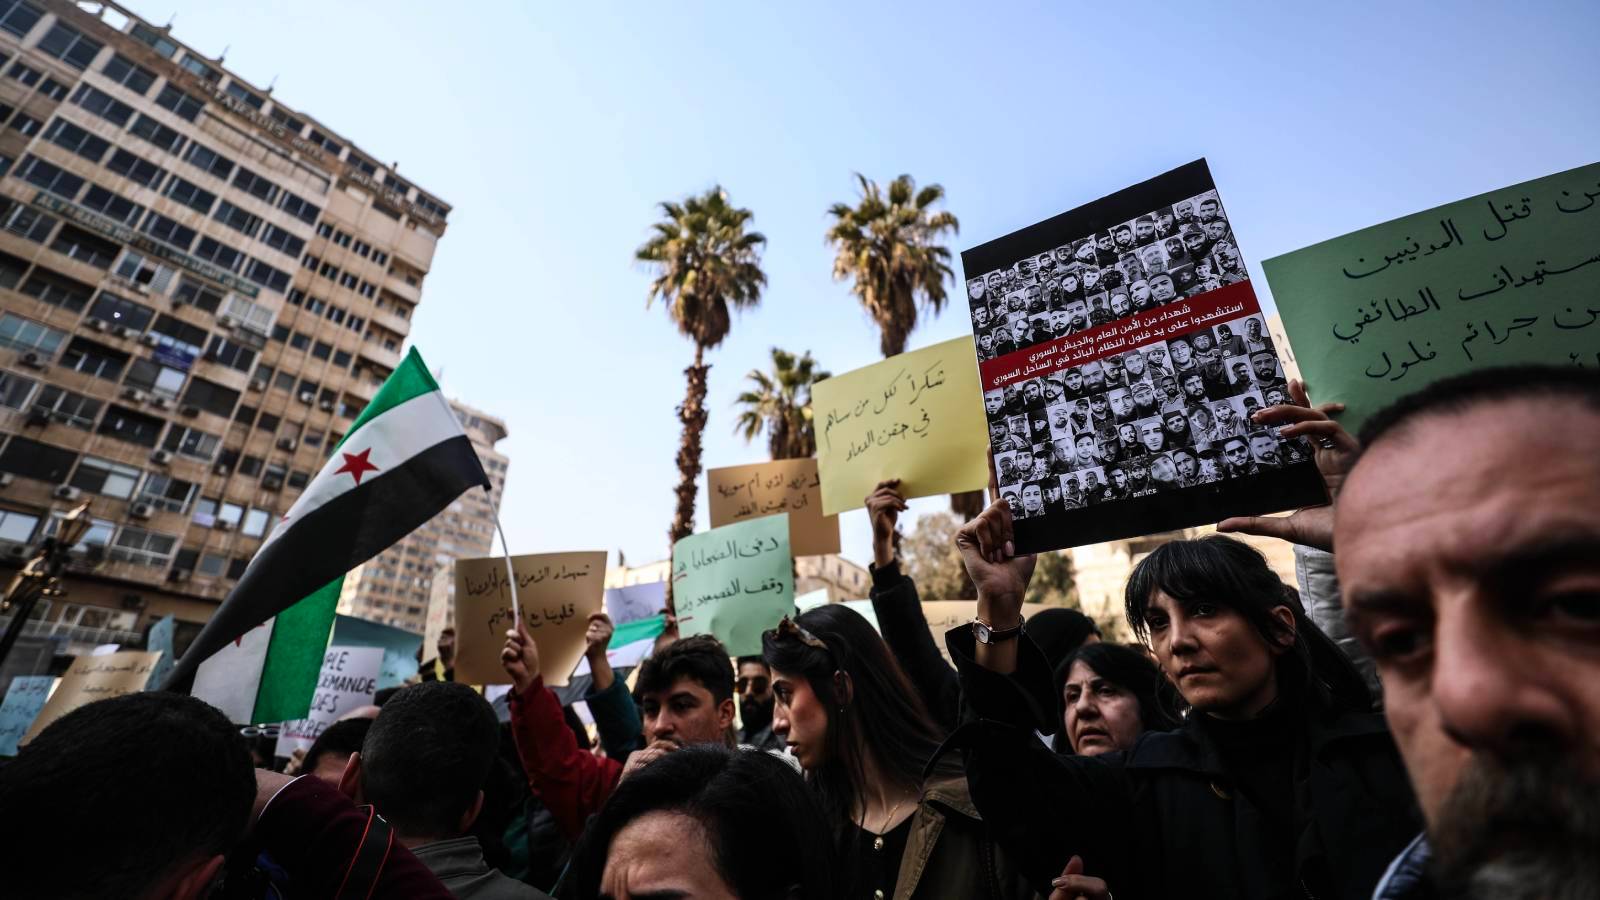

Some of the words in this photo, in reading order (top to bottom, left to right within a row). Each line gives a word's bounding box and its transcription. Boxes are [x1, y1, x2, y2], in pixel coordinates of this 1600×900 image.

[1483, 197, 1532, 242] قتل
[1144, 316, 1158, 327] من
[1160, 305, 1191, 323] شهداء
[1191, 303, 1244, 324] استشهدوا
[1332, 286, 1441, 344] الطائفي
[1096, 327, 1118, 343] العام
[1120, 318, 1142, 337] الأمن
[1153, 328, 1165, 340] يد
[1167, 320, 1189, 336] على
[1060, 335, 1094, 353] والجيش
[1097, 336, 1127, 354] النظام
[1127, 330, 1151, 346] فلول
[1461, 314, 1539, 361] جرائم
[1028, 345, 1058, 363] السوري
[1055, 352, 1070, 367] في
[1072, 345, 1096, 360] البائد
[1365, 340, 1437, 381] فلول
[993, 368, 1021, 386] السوري
[1022, 359, 1053, 376] الساحل
[873, 368, 905, 415] لكل
[854, 398, 870, 418] من
[824, 408, 851, 450] ساهم
[912, 408, 931, 438] في
[877, 422, 909, 447] حقن
[846, 430, 874, 462] الدماء
[747, 472, 760, 498] أم
[691, 540, 737, 570] الضحايا
[696, 577, 740, 607] التصعيد
[744, 578, 784, 595] وقف
[529, 613, 542, 628] مع
[544, 603, 575, 625] قلوبنا
[317, 673, 376, 696] EMANDE
